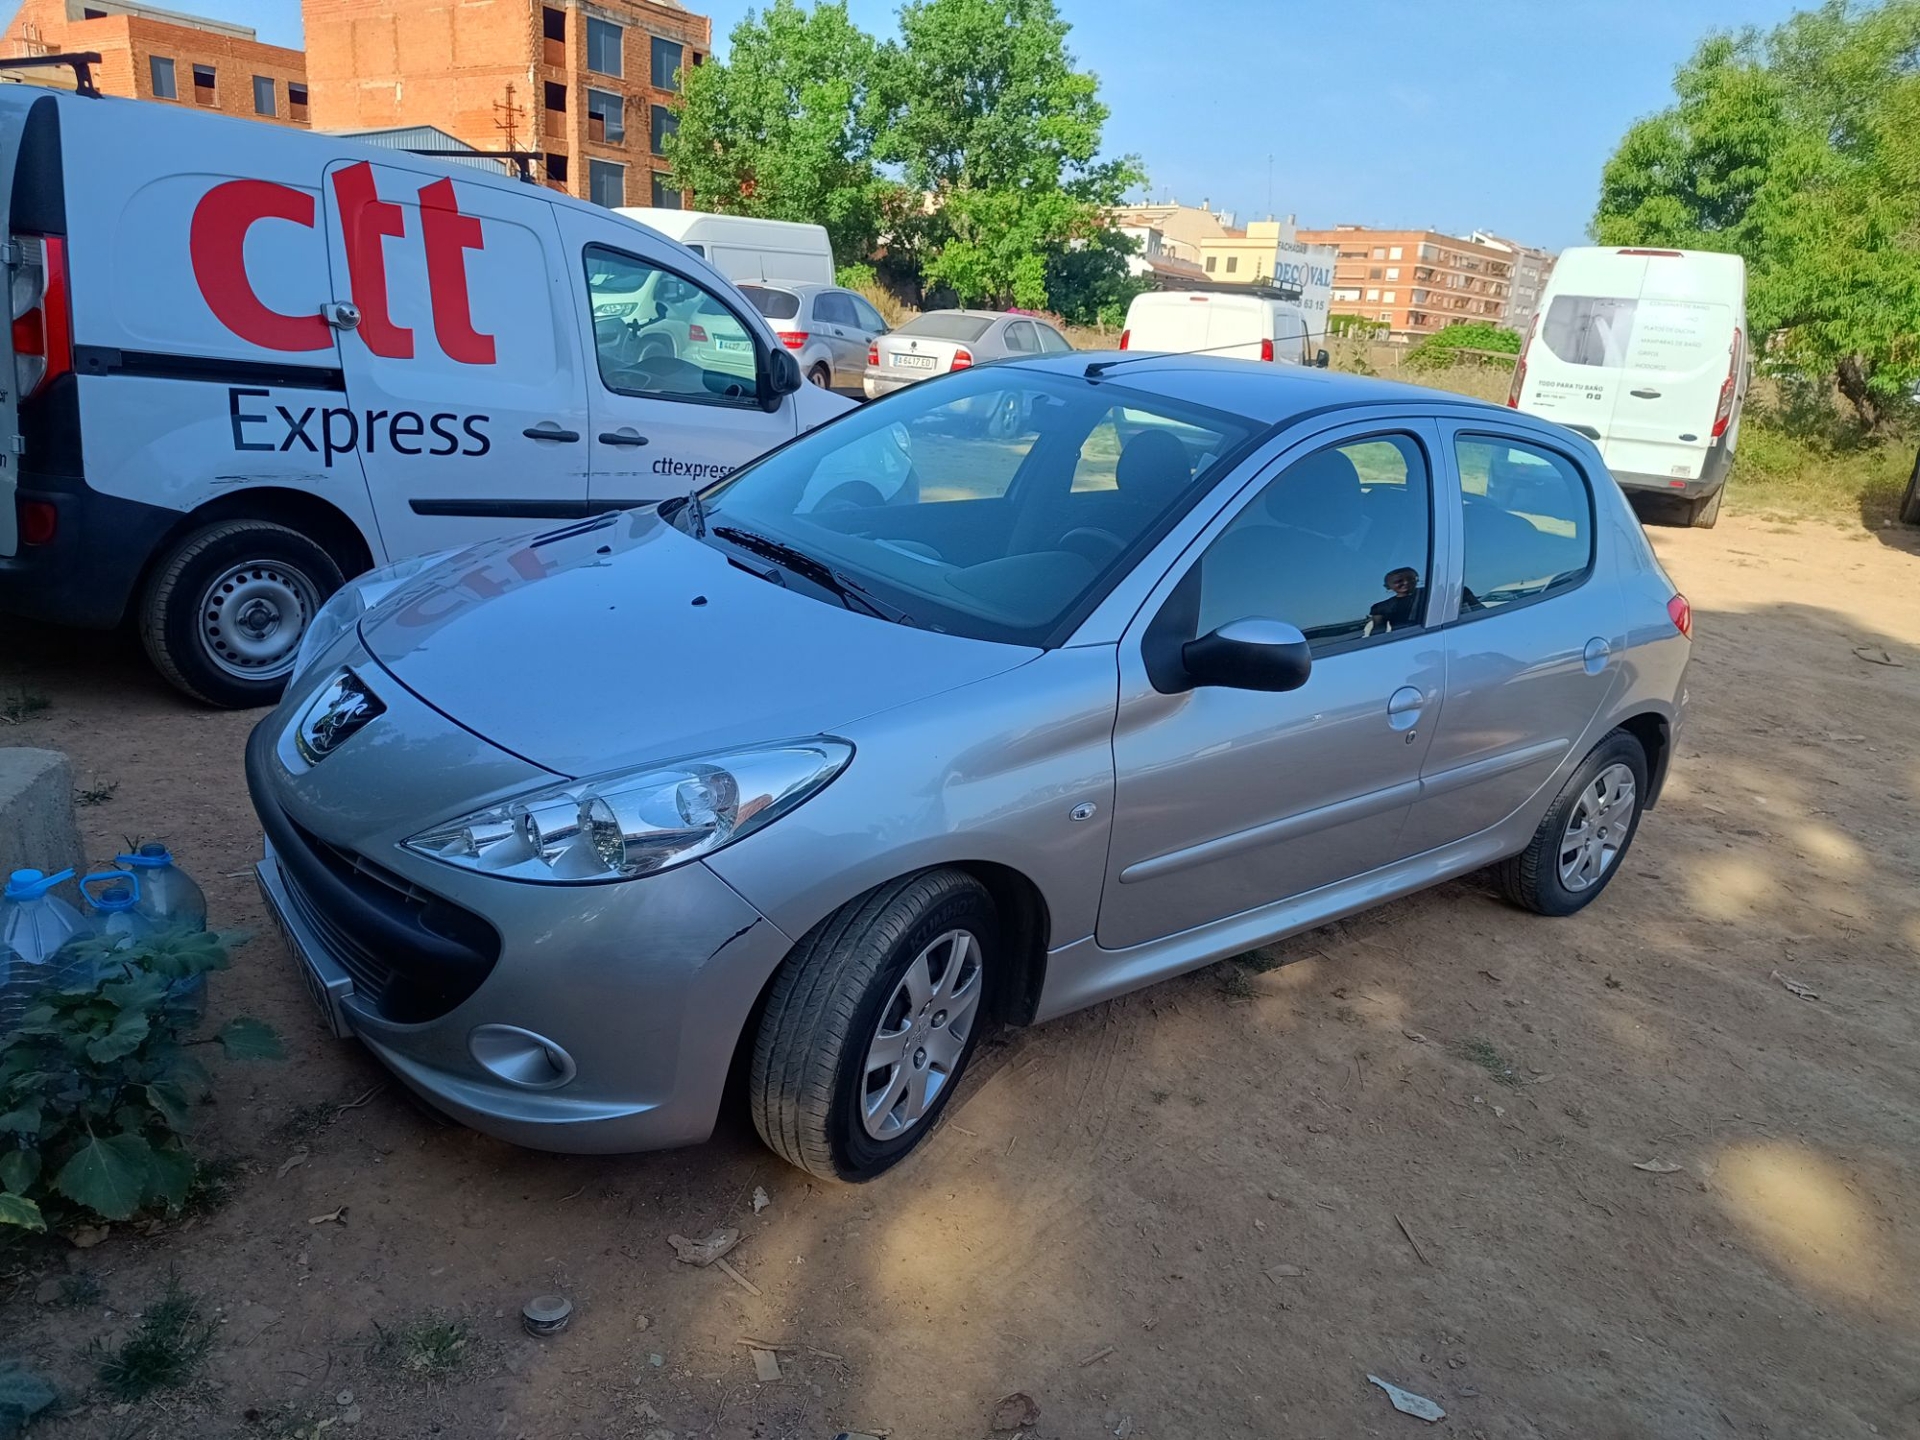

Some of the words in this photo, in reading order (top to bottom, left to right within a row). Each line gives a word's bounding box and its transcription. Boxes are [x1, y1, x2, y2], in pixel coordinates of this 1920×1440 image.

[189, 160, 497, 365] ctt
[1275, 262, 1331, 288] DECOVAL
[1538, 380, 1556, 388] TODO
[1584, 384, 1604, 392] BAÑO
[229, 387, 492, 468] Express
